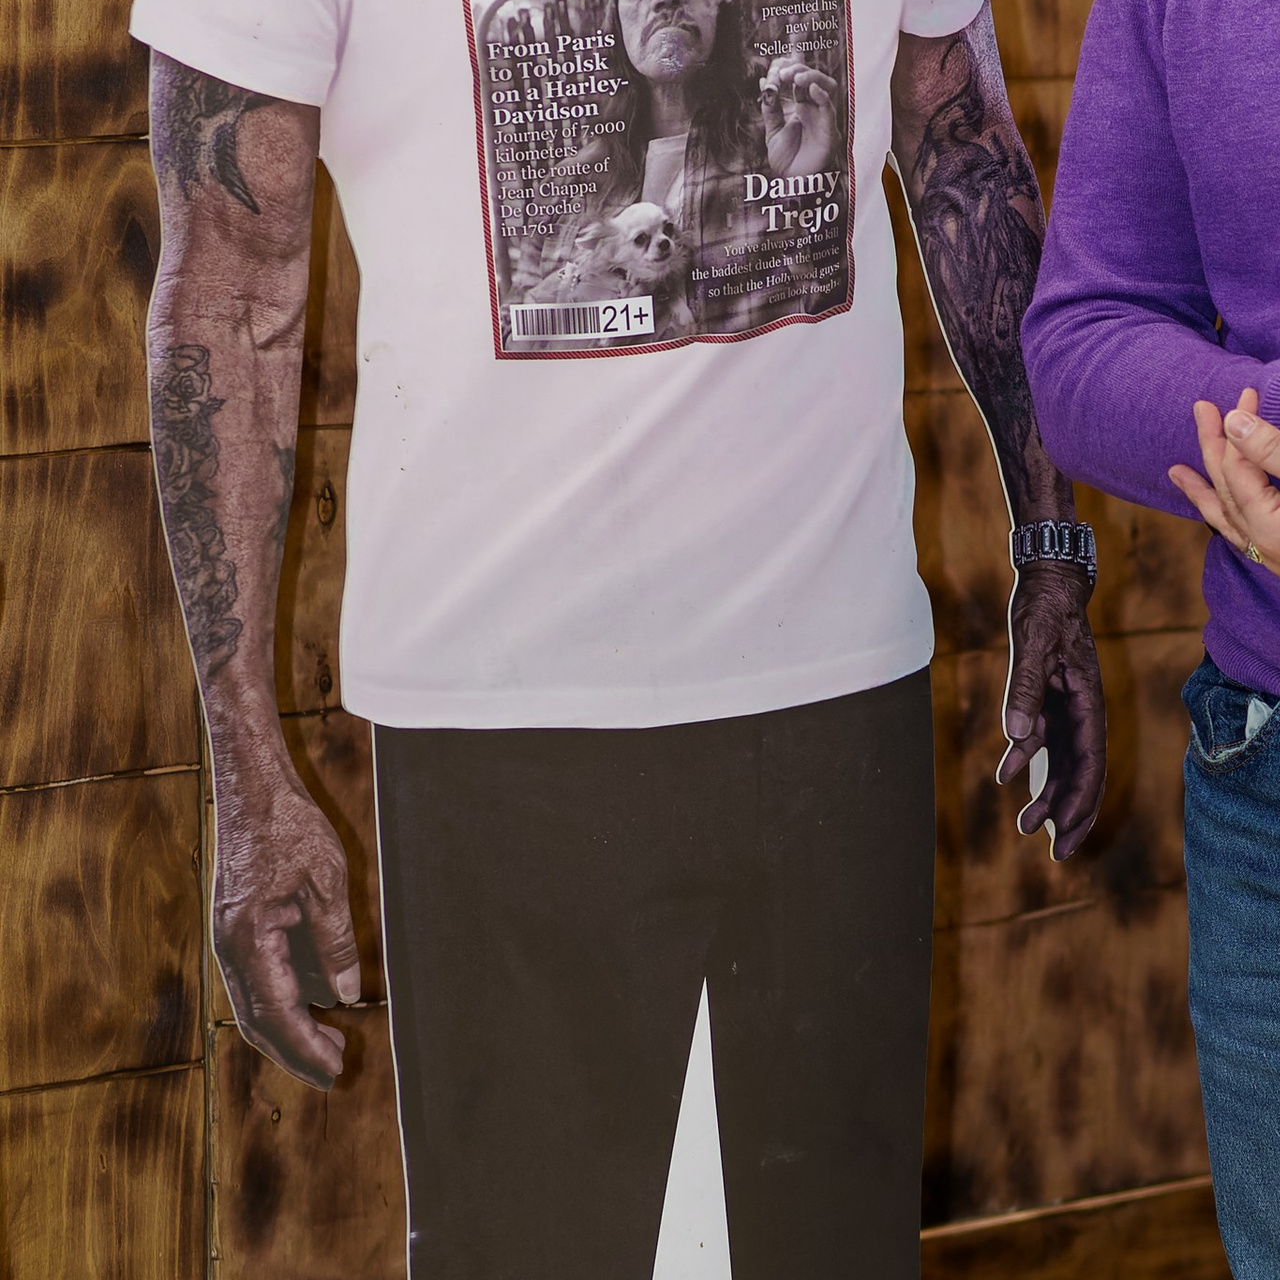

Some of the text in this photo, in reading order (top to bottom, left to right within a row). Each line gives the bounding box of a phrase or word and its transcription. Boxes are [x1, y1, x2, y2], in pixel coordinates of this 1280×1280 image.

[786, 15, 839, 34] new book
[487, 30, 616, 60] From Paris
[489, 52, 609, 82] to Tobolsk
[491, 76, 629, 104] on a Harley-
[493, 102, 600, 126] Davidson
[494, 120, 626, 144] Journey of 7,000
[495, 145, 578, 163] kilometers
[496, 156, 610, 182] on the route of
[498, 182, 598, 200] Jean Chappa
[743, 170, 841, 202] Danny
[500, 200, 581, 218] De Oroche
[762, 198, 840, 233] Trejo
[502, 220, 554, 238] in 1761
[724, 226, 840, 258] You've always got to kill
[692, 246, 840, 281] the baddest dude in the movie
[708, 262, 840, 298] so that the Hollywood guys
[768, 292, 786, 304] can
[788, 284, 808, 299] look
[602, 303, 649, 333] 21+
